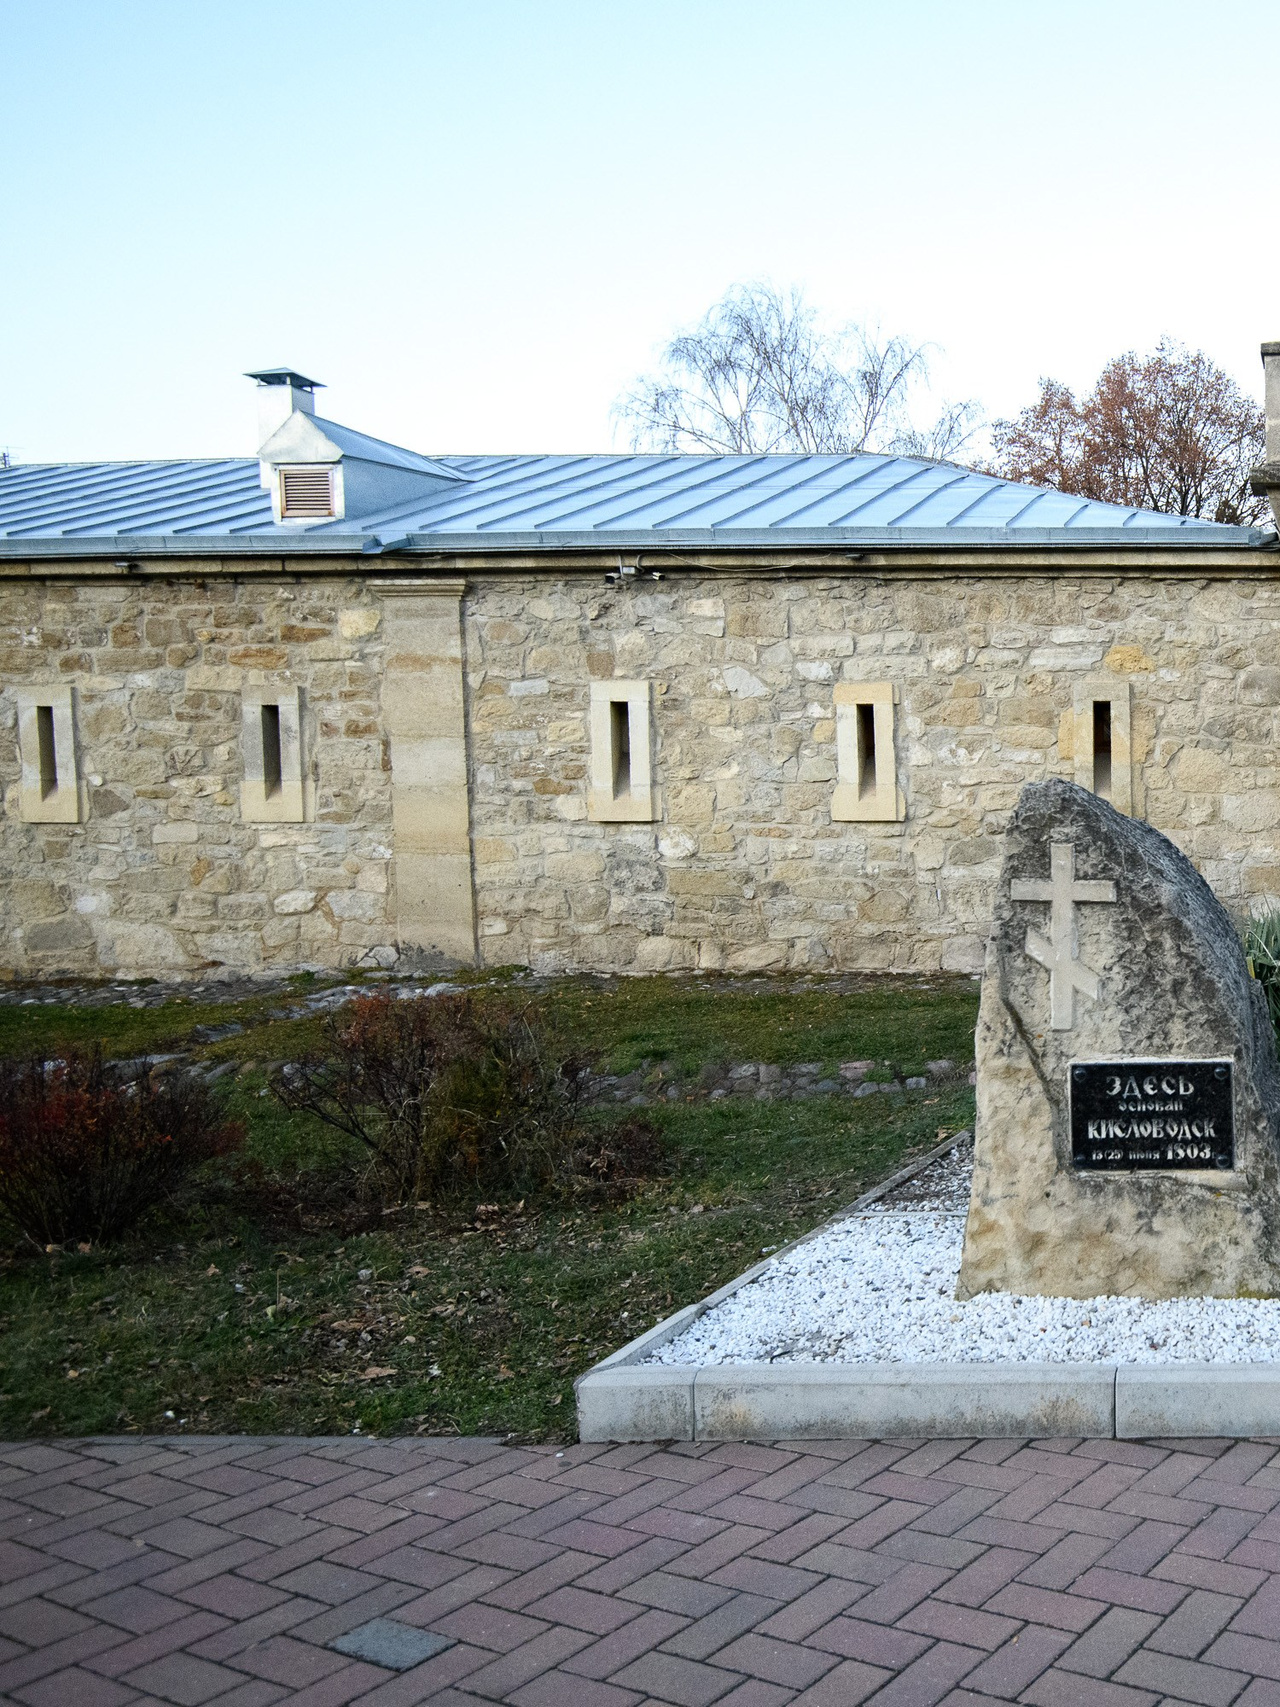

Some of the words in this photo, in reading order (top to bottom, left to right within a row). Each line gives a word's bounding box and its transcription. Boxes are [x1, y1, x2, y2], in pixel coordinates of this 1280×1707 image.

[1105, 1075, 1195, 1100] ЗДЕСЬ
[1118, 1100, 1184, 1112] основан
[1087, 1117, 1216, 1141] КИСЛОВОДСК
